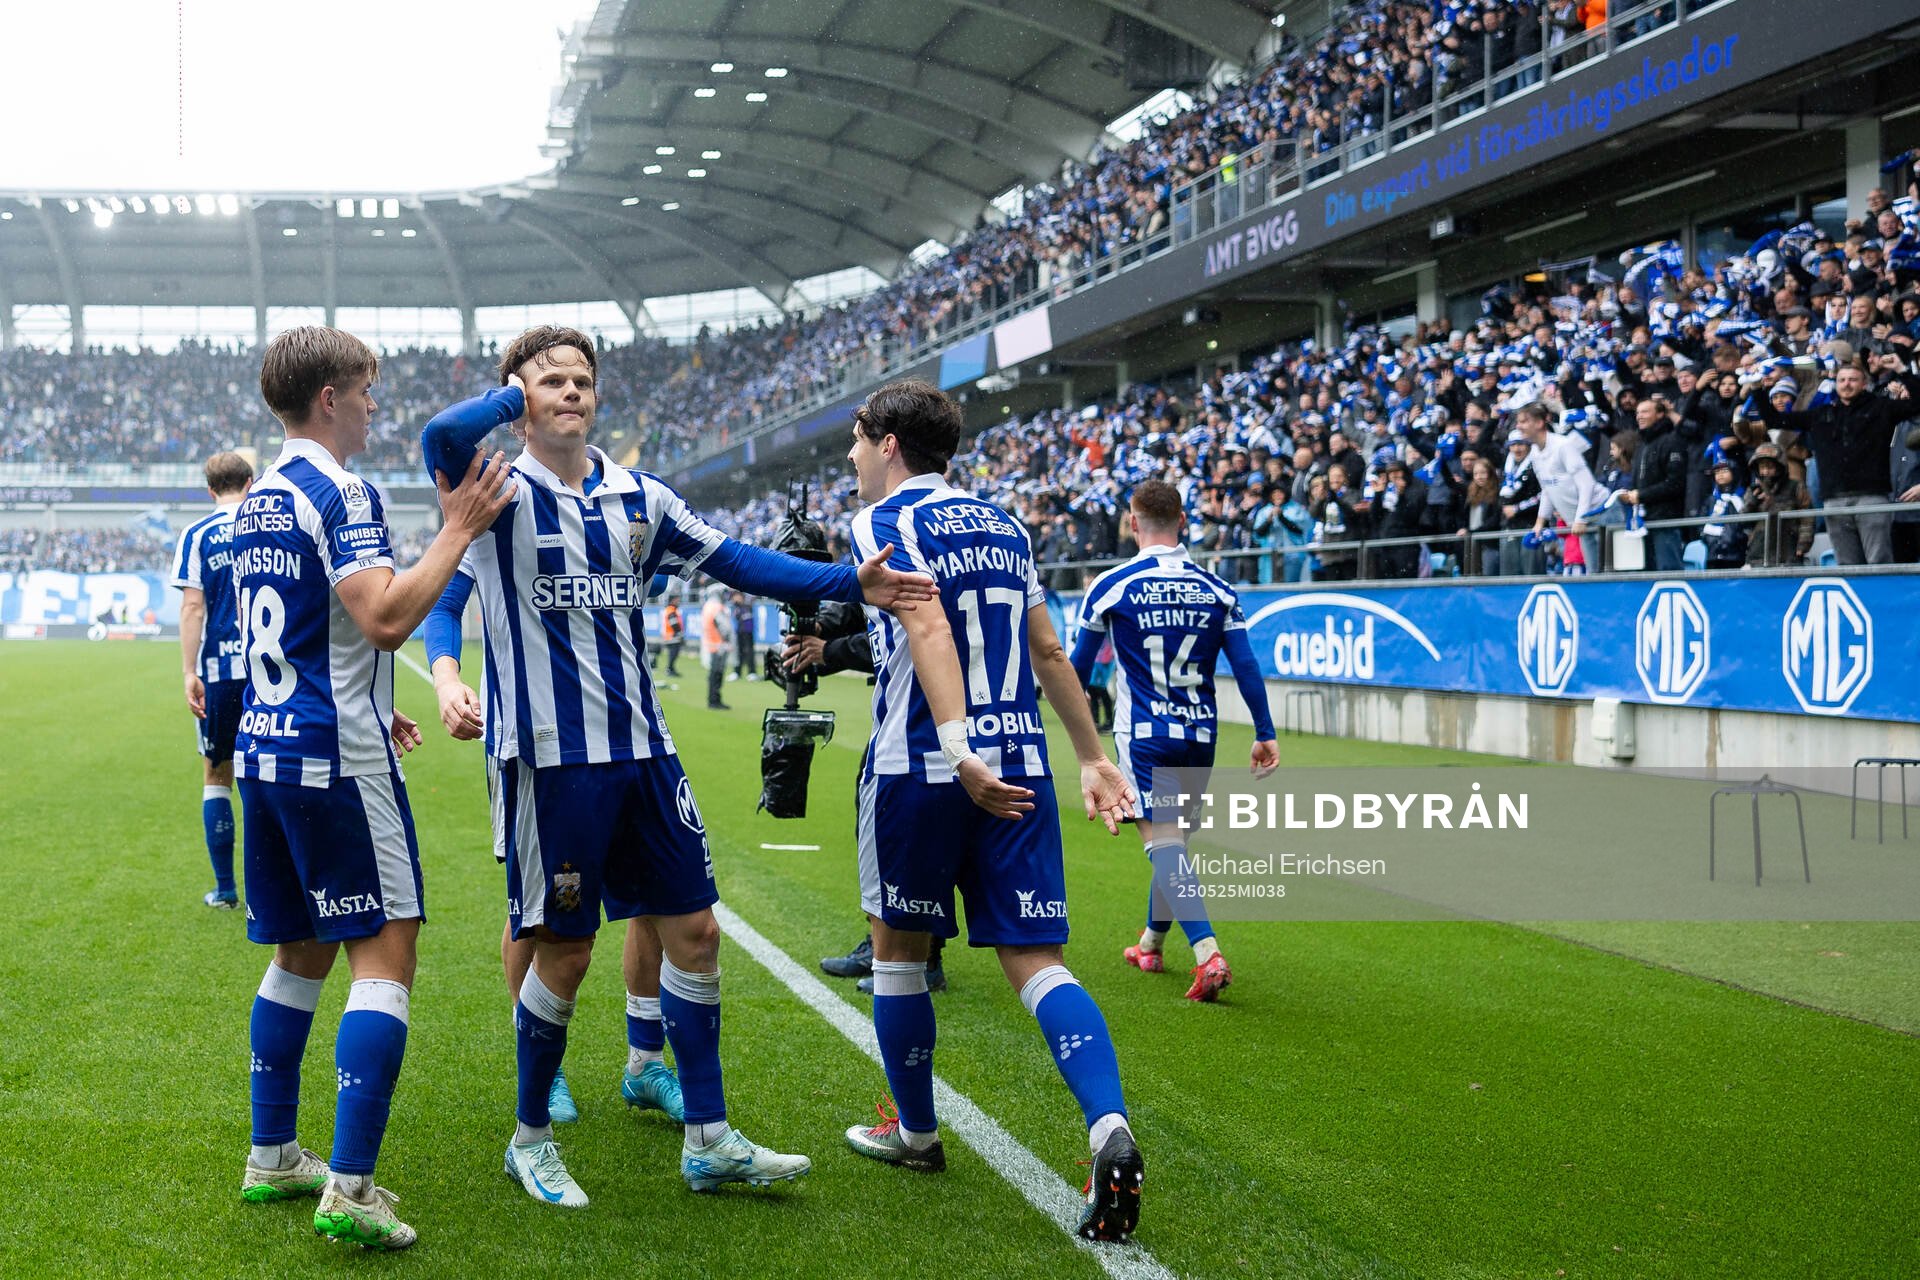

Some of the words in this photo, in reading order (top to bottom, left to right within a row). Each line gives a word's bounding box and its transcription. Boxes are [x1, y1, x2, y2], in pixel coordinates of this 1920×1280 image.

[1325, 192, 1356, 228] Din
[1361, 158, 1430, 214] expert
[1436, 134, 1471, 182] vid
[1479, 33, 1740, 165] försäkringsskador
[1204, 232, 1243, 277] AMT
[1247, 209, 1298, 261] BYGG
[235, 514, 293, 537] WELLNESS
[924, 518, 1018, 538] WELLNESS
[932, 504, 999, 521] NORDIC
[339, 527, 384, 542] UNIBET
[234, 547, 301, 580] RIKSSON
[358, 558, 376, 568] IFK
[928, 546, 1028, 583] MARKOVIC
[0, 570, 151, 625] ER
[531, 574, 643, 610] SERNEK
[1129, 592, 1216, 605] WELLNESS
[1143, 581, 1201, 594] NORDIC
[1137, 609, 1211, 629] HEINTZ
[241, 585, 298, 706] 18
[958, 587, 1024, 706] 17
[1274, 614, 1375, 680] cuebid
[1523, 594, 1572, 686] MG
[1642, 592, 1703, 692] MG
[1790, 590, 1864, 702] MG
[1143, 634, 1203, 704] 14
[1144, 795, 1179, 809] RAST
[316, 892, 380, 918] RASTA
[886, 893, 945, 918] RASTA
